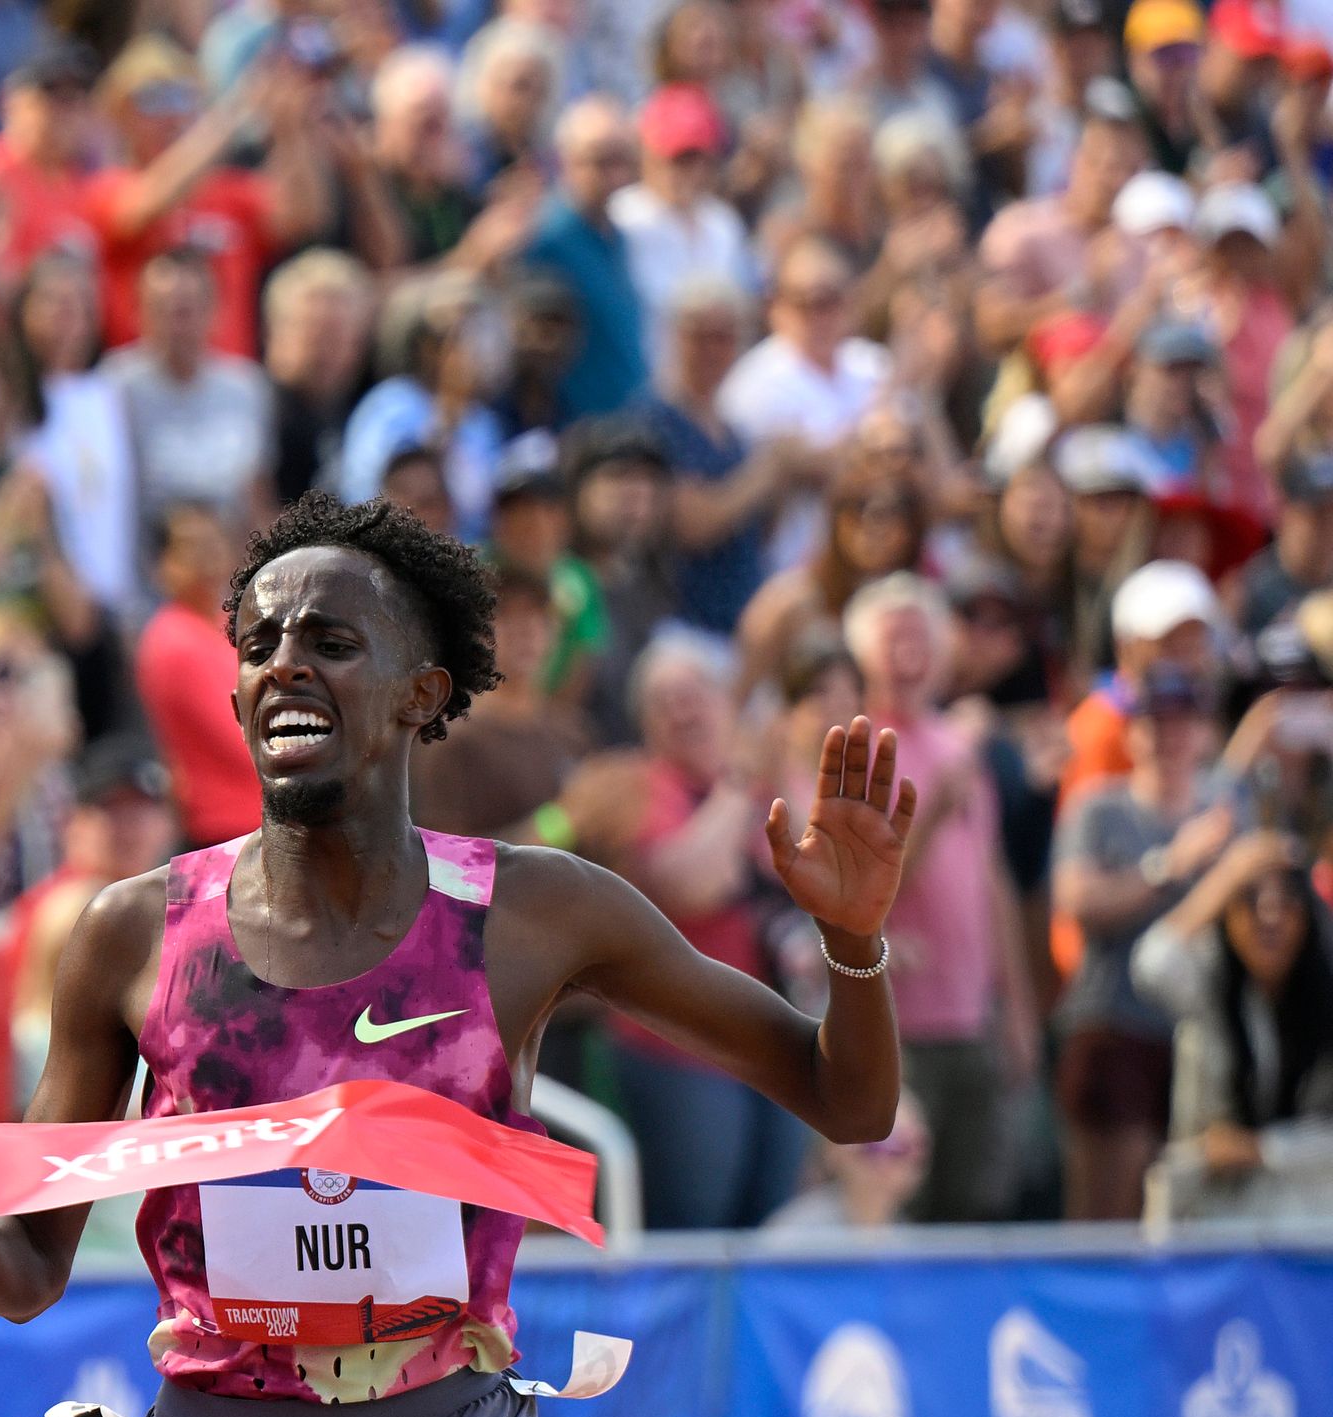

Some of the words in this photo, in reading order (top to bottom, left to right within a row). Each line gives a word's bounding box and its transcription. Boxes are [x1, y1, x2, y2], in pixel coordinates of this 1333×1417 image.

[42, 1107, 346, 1183] xfinity
[308, 1189, 333, 1205] OLYMPIC
[336, 1188, 352, 1203] TEAM
[295, 1223, 372, 1271] NUR
[225, 1307, 300, 1325] TRACKTOWN
[266, 1321, 297, 1337] 2024
